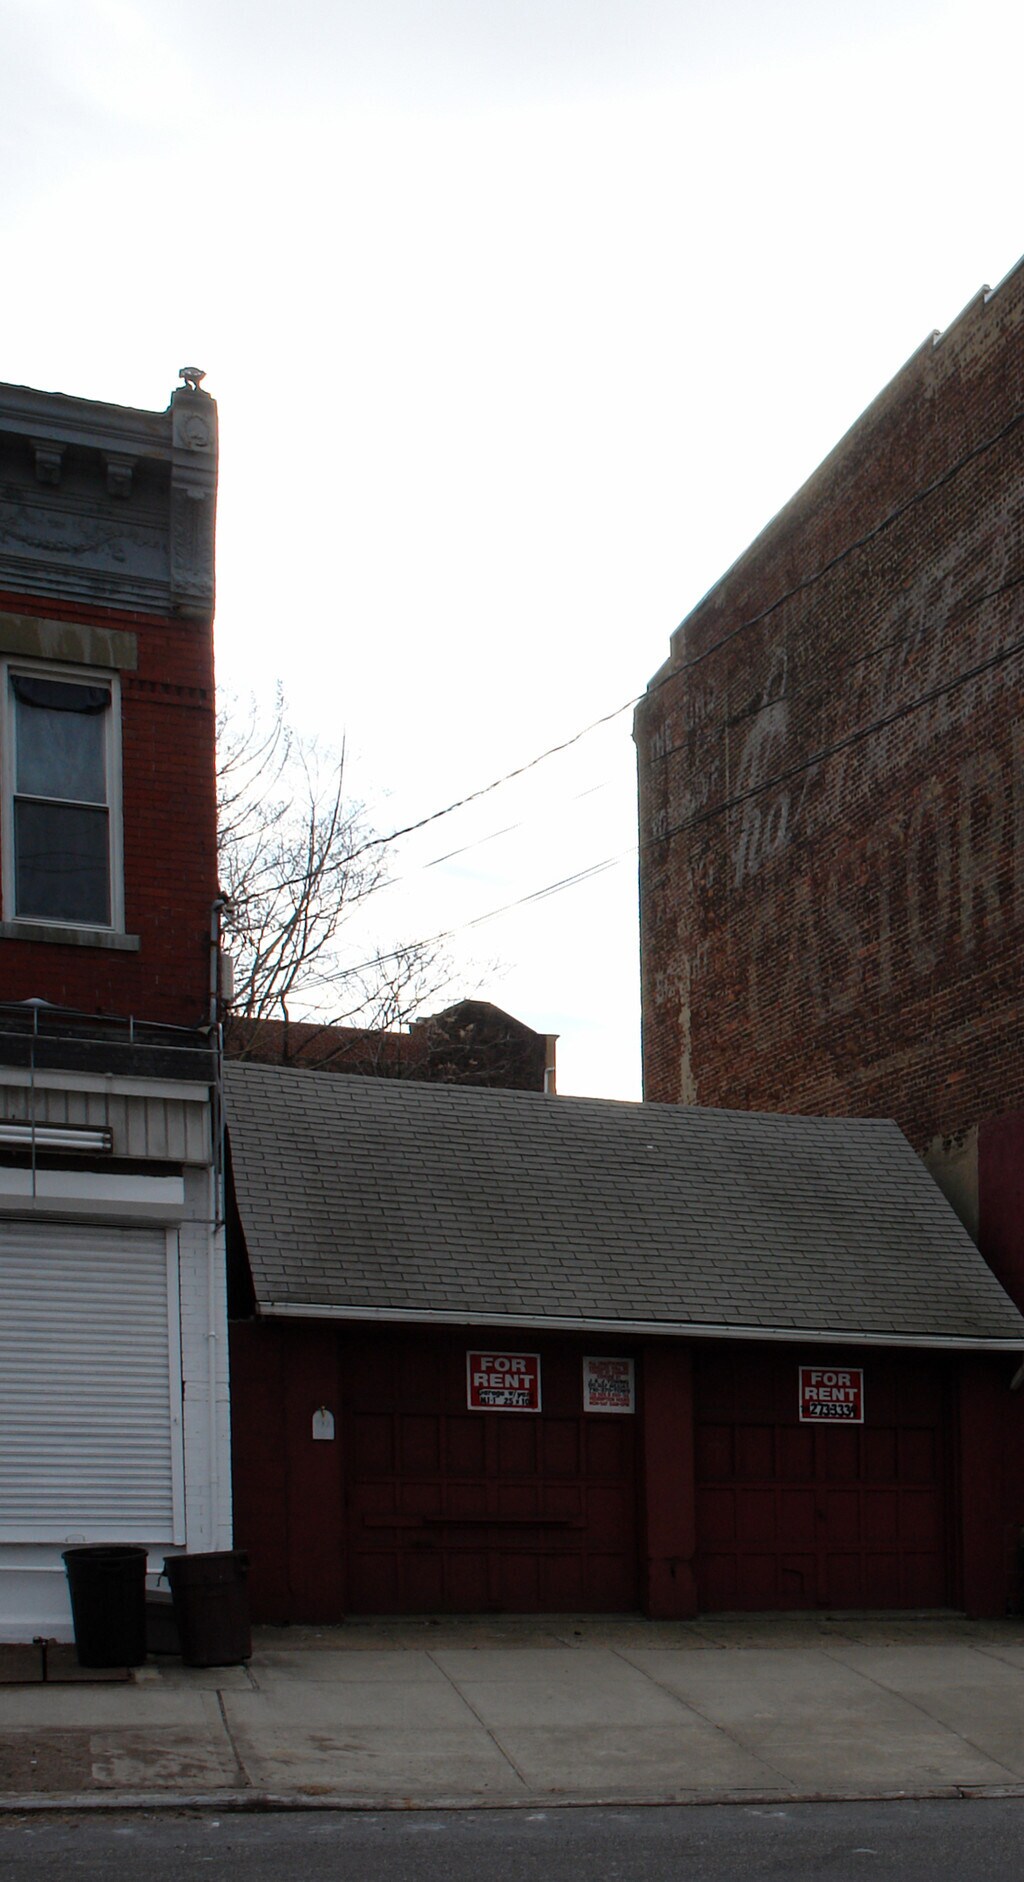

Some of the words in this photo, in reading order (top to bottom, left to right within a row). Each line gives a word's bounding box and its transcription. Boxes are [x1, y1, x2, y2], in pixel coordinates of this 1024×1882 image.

[481, 1357, 527, 1372] FOR
[473, 1372, 534, 1389] RENT
[810, 1371, 851, 1386] FOR
[804, 1386, 858, 1402] RENT
